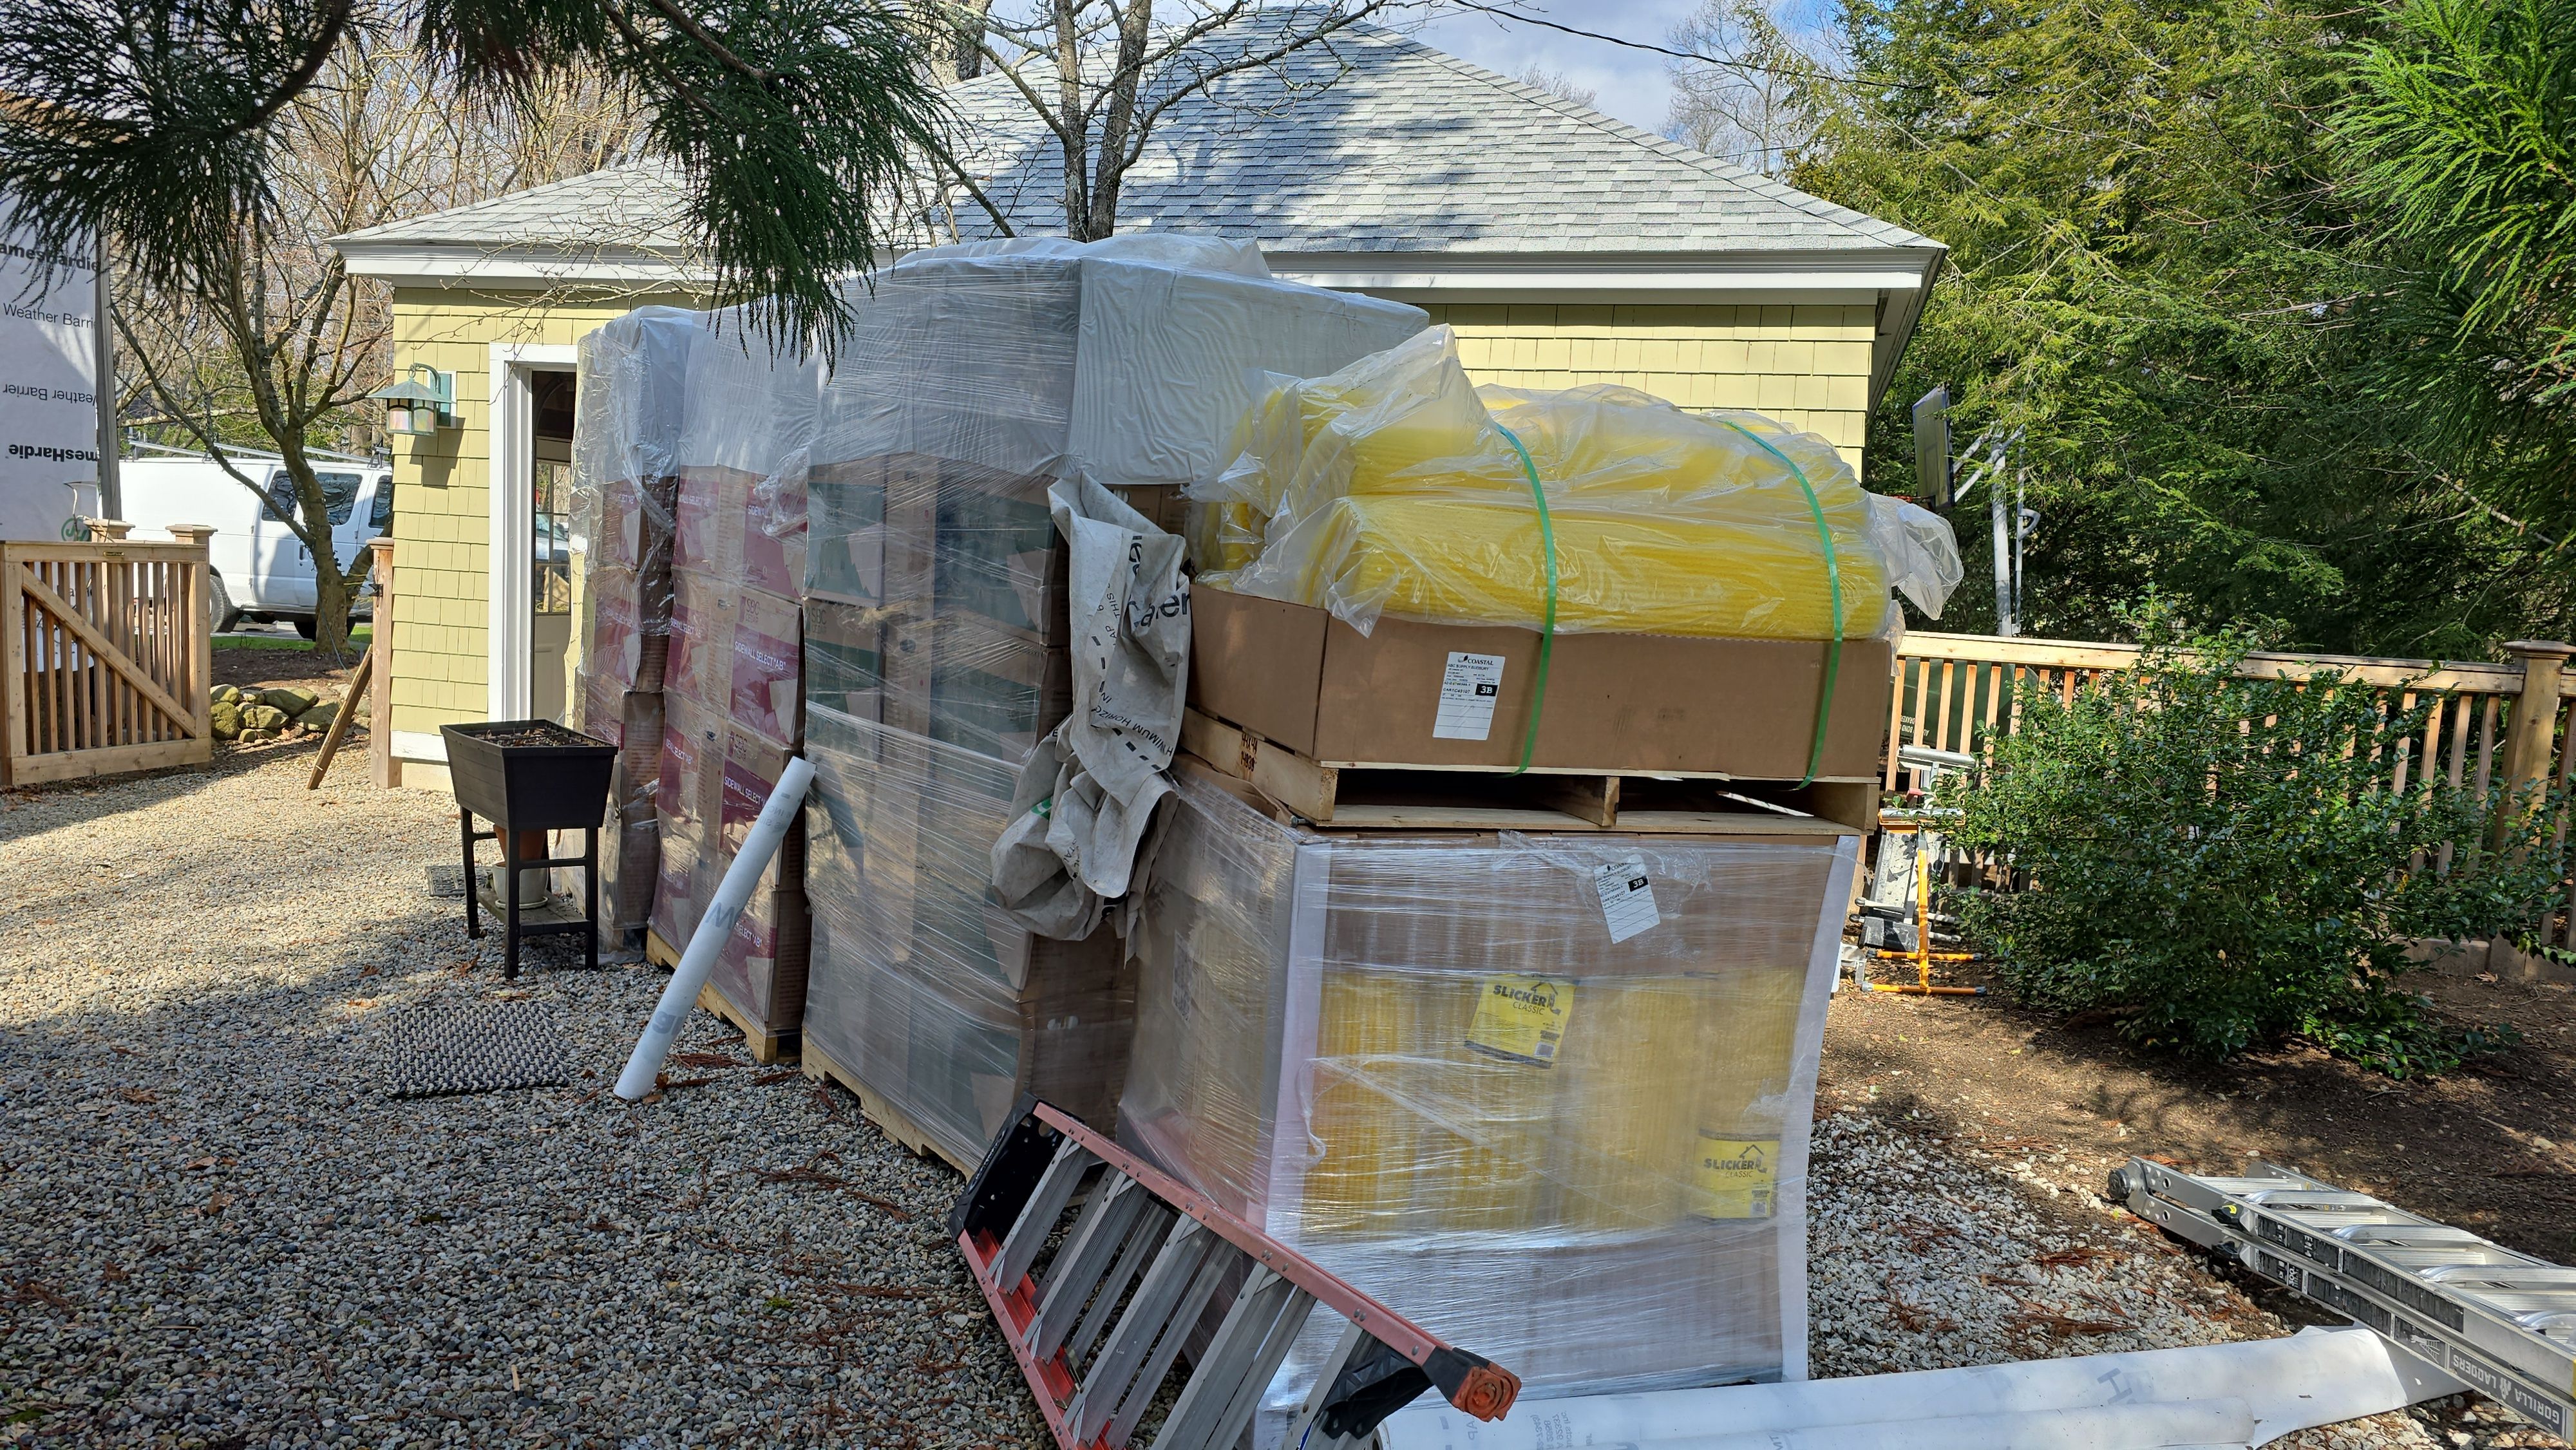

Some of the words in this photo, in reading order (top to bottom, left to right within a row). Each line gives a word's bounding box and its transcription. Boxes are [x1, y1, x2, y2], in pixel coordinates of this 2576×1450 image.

[3, 303, 59, 323] Weather
[3, 383, 48, 401] Barrier
[52, 389, 95, 406] eather
[746, 598, 761, 616] SBC
[734, 641, 756, 660] SIDEWALL
[756, 650, 773, 667] SELECT
[724, 776, 746, 795] SIDEWALL
[745, 787, 762, 805] SELECT
[1633, 878, 1645, 888] 3B
[1493, 984, 1546, 1007] SLICKER
[1513, 1001, 1546, 1015] CLASSIC
[1703, 1158, 1755, 1171] SLICKER
[2453, 1354, 2497, 1389] LADDERS
[2514, 1388, 2560, 1425] GORILLA
